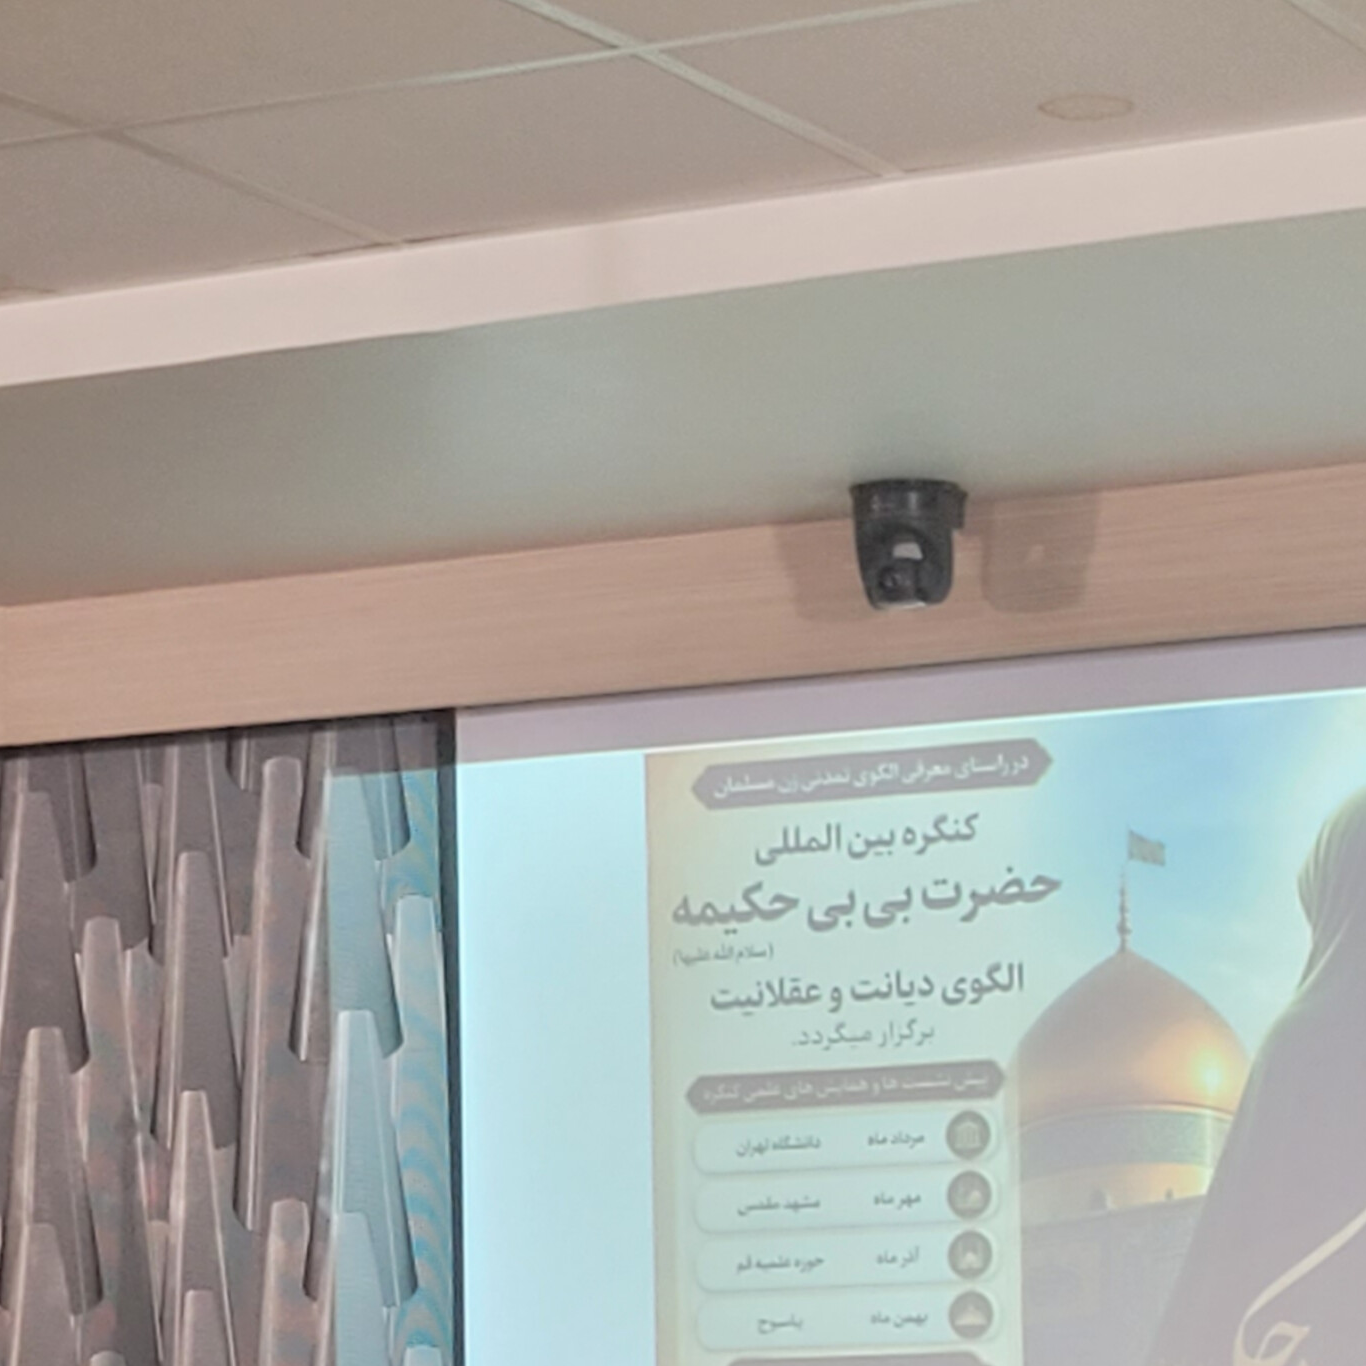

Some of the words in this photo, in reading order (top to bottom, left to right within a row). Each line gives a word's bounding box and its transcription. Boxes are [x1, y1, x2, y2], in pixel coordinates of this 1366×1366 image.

[853, 763, 899, 788] الگوی
[902, 759, 951, 783] معرفی
[714, 775, 774, 798] مسلمان
[755, 823, 842, 866] المللی
[847, 827, 894, 859] بین
[902, 813, 979, 856] کنگره
[672, 882, 799, 935] حکیمه
[864, 884, 912, 927] بی
[922, 866, 1062, 923] حضرت
[807, 889, 855, 931] بی
[711, 977, 822, 1016] عقلانیت
[850, 970, 934, 1006] دیانت
[941, 962, 1024, 1005] الگوی
[828, 985, 843, 1013] و
[877, 1018, 934, 1048] برگزار
[737, 1141, 770, 1158] تهران
[772, 1134, 821, 1150] دانشگاه
[868, 1134, 888, 1146] ماه
[891, 1132, 925, 1149] مرداد
[873, 1192, 894, 1206] ماه
[897, 1191, 922, 1210] مهر
[876, 1250, 899, 1266] ماه
[870, 1311, 891, 1327] ماه
